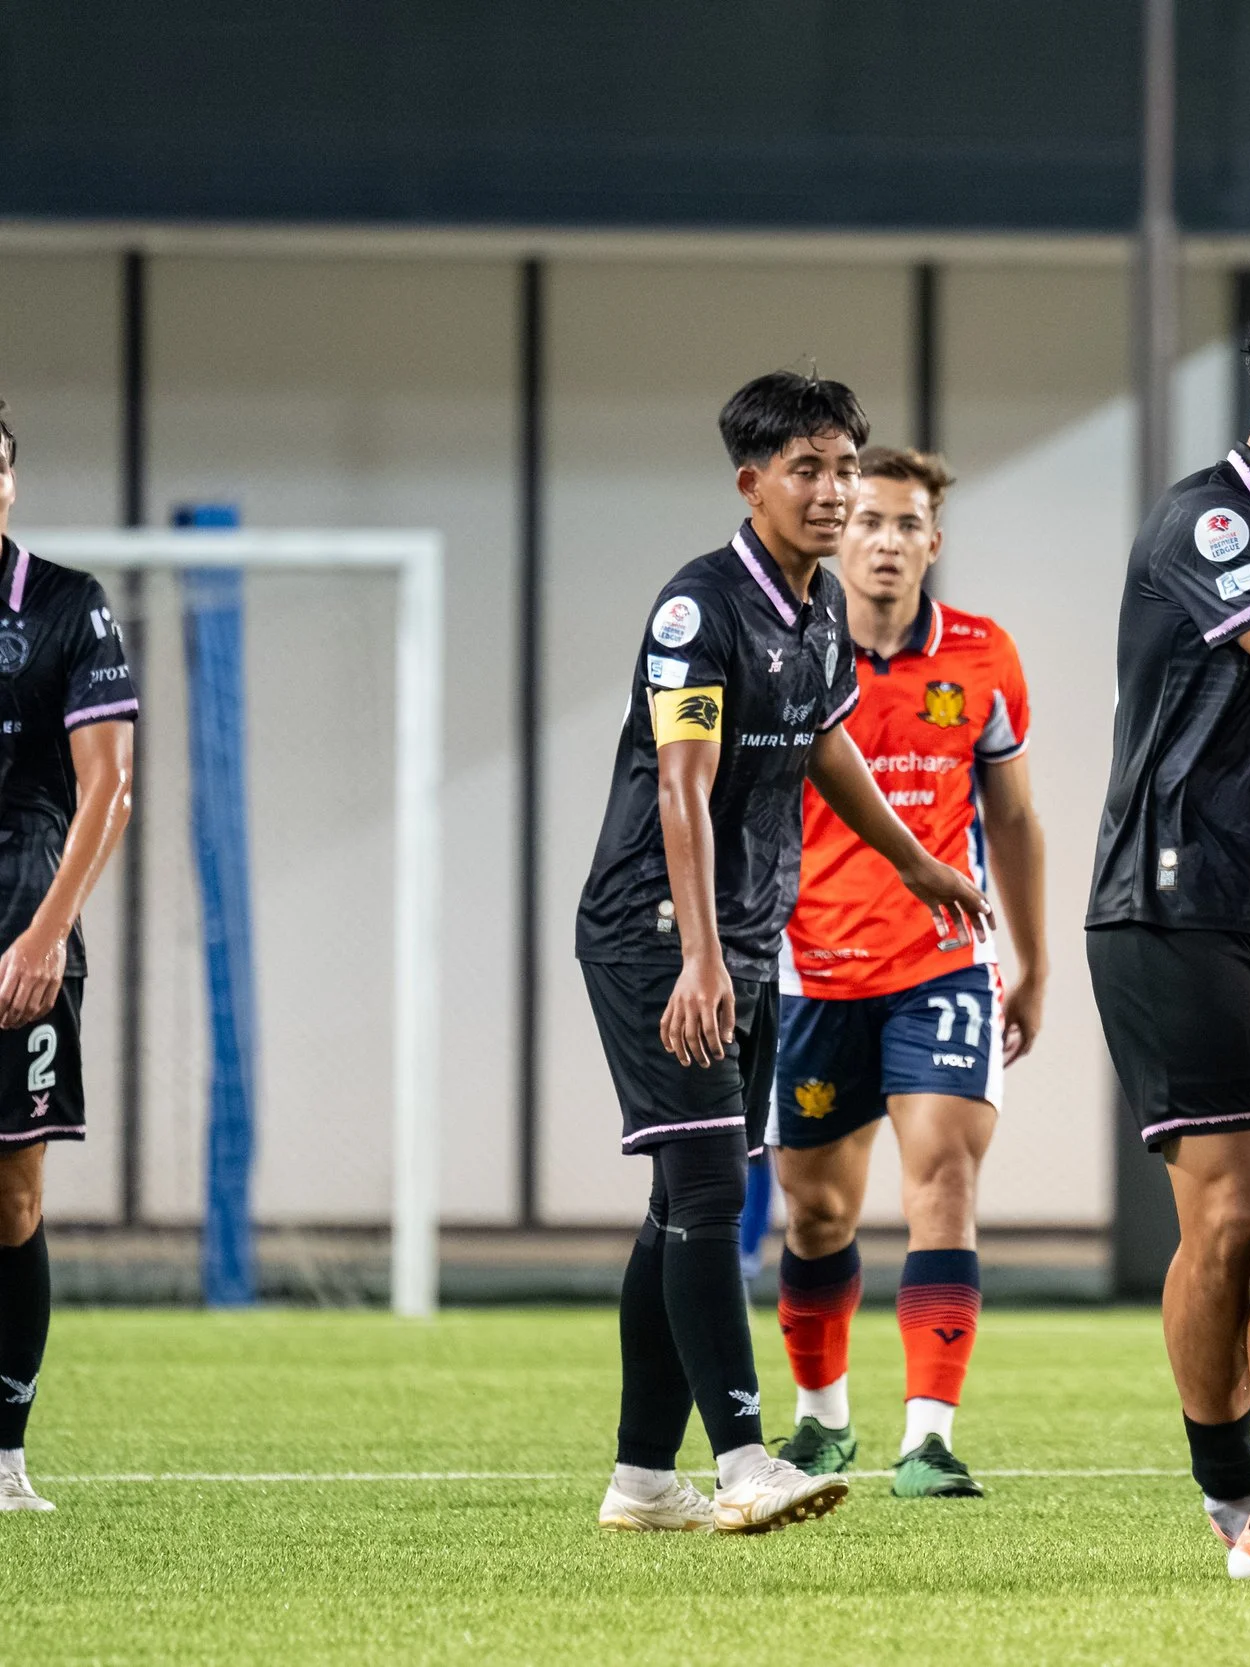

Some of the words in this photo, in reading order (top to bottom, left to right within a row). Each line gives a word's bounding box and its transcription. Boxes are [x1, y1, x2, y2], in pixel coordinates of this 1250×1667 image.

[1212, 543, 1241, 558] LEAGUE
[886, 790, 935, 806] IKIN
[27, 1023, 57, 1092] 2
